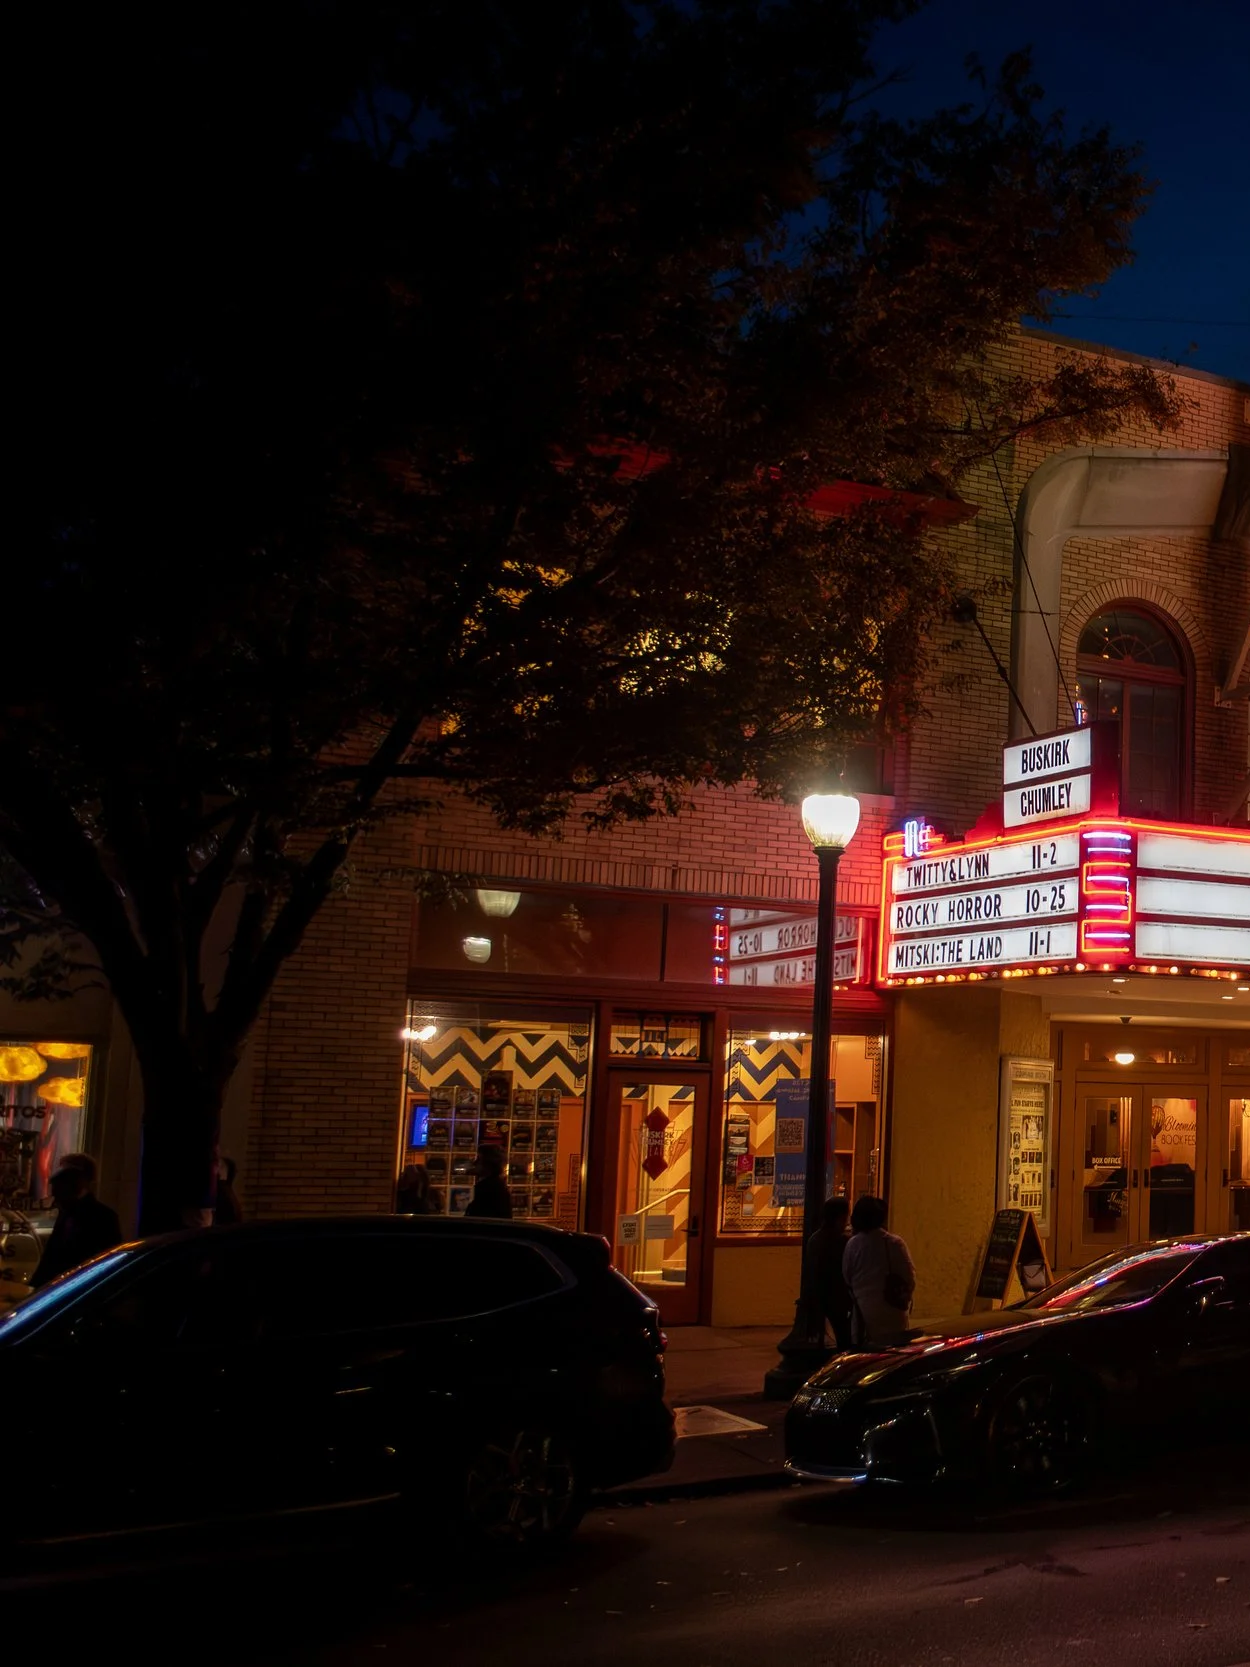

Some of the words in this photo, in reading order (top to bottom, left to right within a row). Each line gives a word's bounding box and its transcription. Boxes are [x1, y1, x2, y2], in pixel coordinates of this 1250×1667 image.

[1021, 739, 1071, 774] BUSKIRK
[1020, 782, 1072, 817] CHUMLEY
[907, 852, 990, 888] TWITTY&LYNN
[1032, 842, 1057, 867] 11-2
[896, 902, 939, 929] ROCKY
[948, 894, 1002, 921] HORROR
[1026, 884, 1066, 914] 10-25
[895, 940, 963, 968] MITSKI:THE
[970, 936, 1003, 961] LAND
[1029, 930, 1051, 957] 11-1
